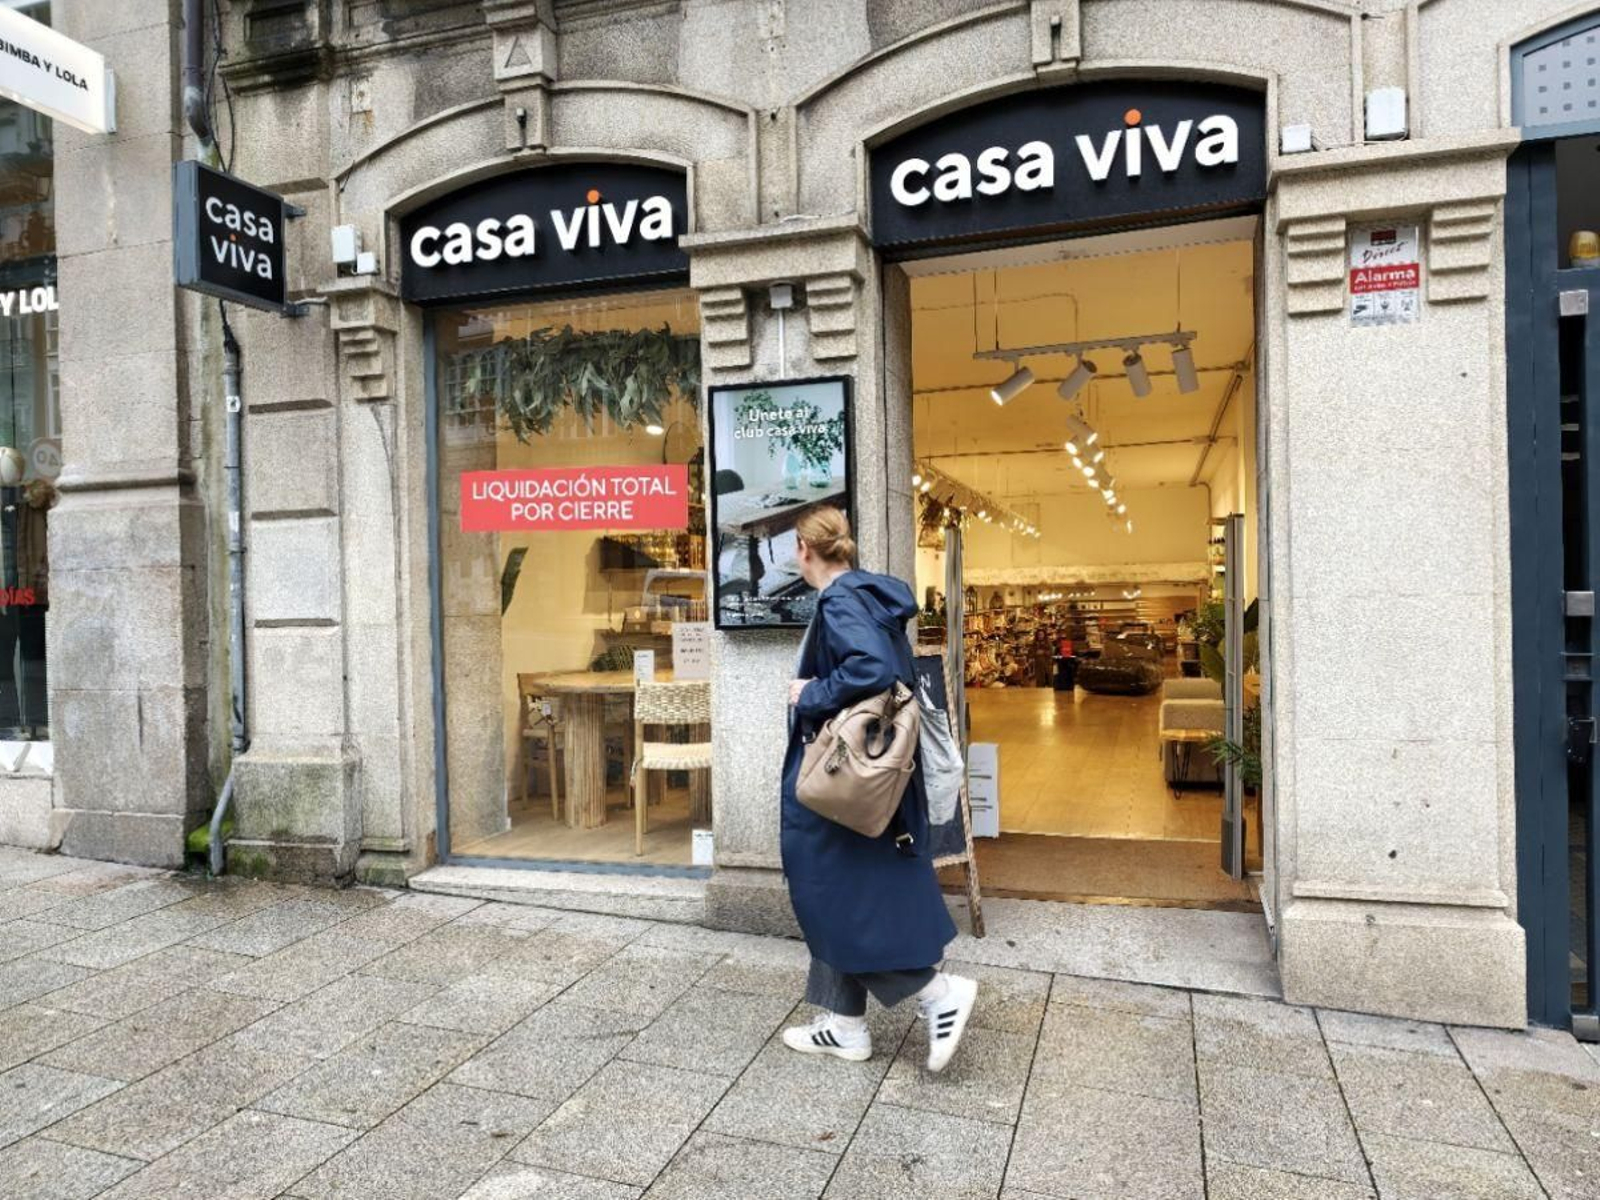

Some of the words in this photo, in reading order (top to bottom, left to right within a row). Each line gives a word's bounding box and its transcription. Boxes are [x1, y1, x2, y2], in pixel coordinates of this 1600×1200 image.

[43, 59, 52, 73] Y
[55, 66, 89, 91] LOLA
[890, 140, 1055, 207] casa
[1074, 108, 1239, 182] viva
[205, 196, 274, 244] casa
[410, 213, 536, 268] casa
[550, 189, 674, 251] viva
[210, 233, 273, 280] viva
[1354, 269, 1416, 284] Alarma
[0, 291, 15, 317] Y
[796, 406, 809, 418] al
[734, 426, 764, 440] club
[766, 425, 797, 437] casa
[799, 423, 826, 434] viva
[472, 473, 606, 502] LIQUIDACIÓN
[610, 476, 677, 497] TOTAL
[511, 502, 554, 521] POR
[558, 500, 634, 520] CIERRE
